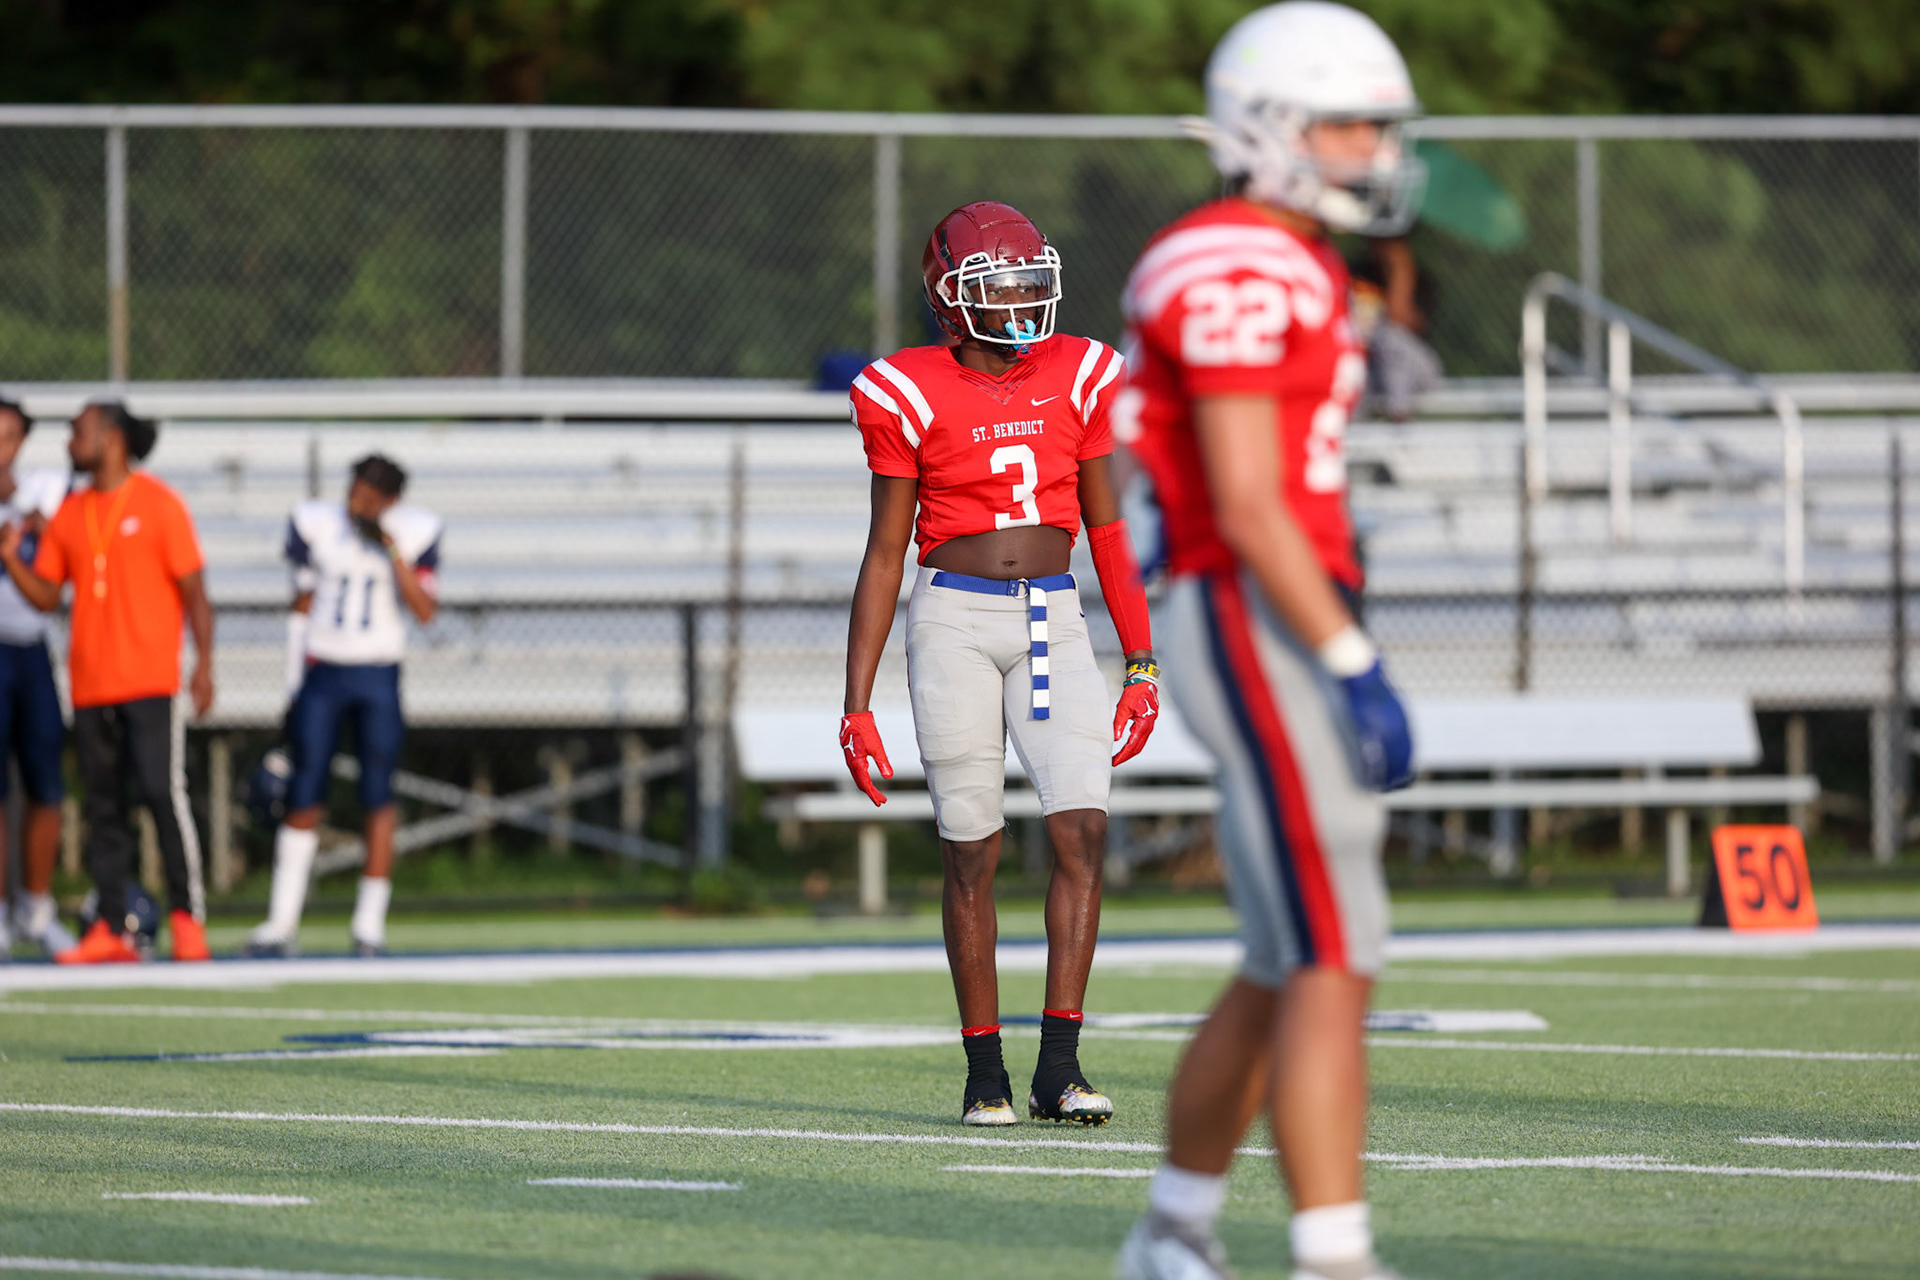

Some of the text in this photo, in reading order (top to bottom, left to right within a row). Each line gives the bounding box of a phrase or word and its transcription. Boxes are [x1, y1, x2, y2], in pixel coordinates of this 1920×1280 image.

[1181, 280, 1290, 367] 22
[972, 420, 1044, 442] ST. BENEDICT
[990, 444, 1041, 530] 3
[332, 574, 377, 630] 11
[1735, 844, 1800, 912] 50
